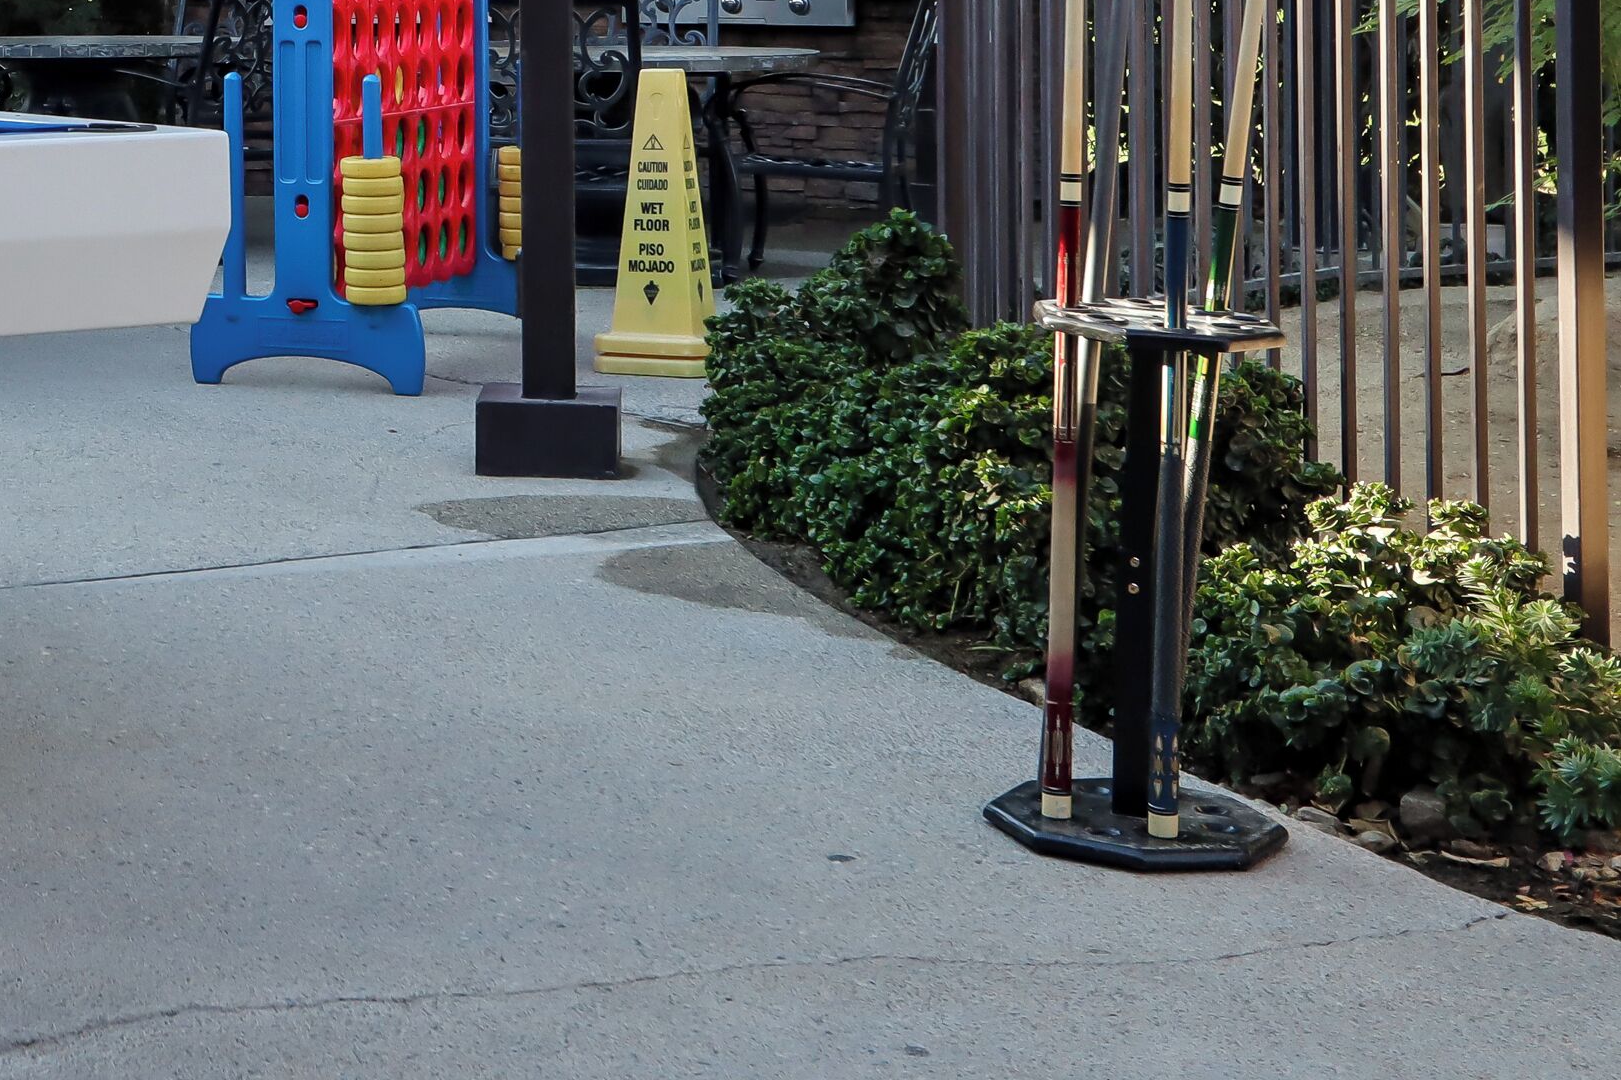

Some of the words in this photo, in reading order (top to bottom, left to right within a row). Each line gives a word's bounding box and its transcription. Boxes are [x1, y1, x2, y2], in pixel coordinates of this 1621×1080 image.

[637, 161, 668, 173] CAUTION
[636, 179, 668, 191] CUIDADO
[641, 202, 664, 215] WET
[633, 219, 670, 232] FLOOR
[638, 243, 665, 256] PISO
[628, 260, 675, 273] MOJADO
